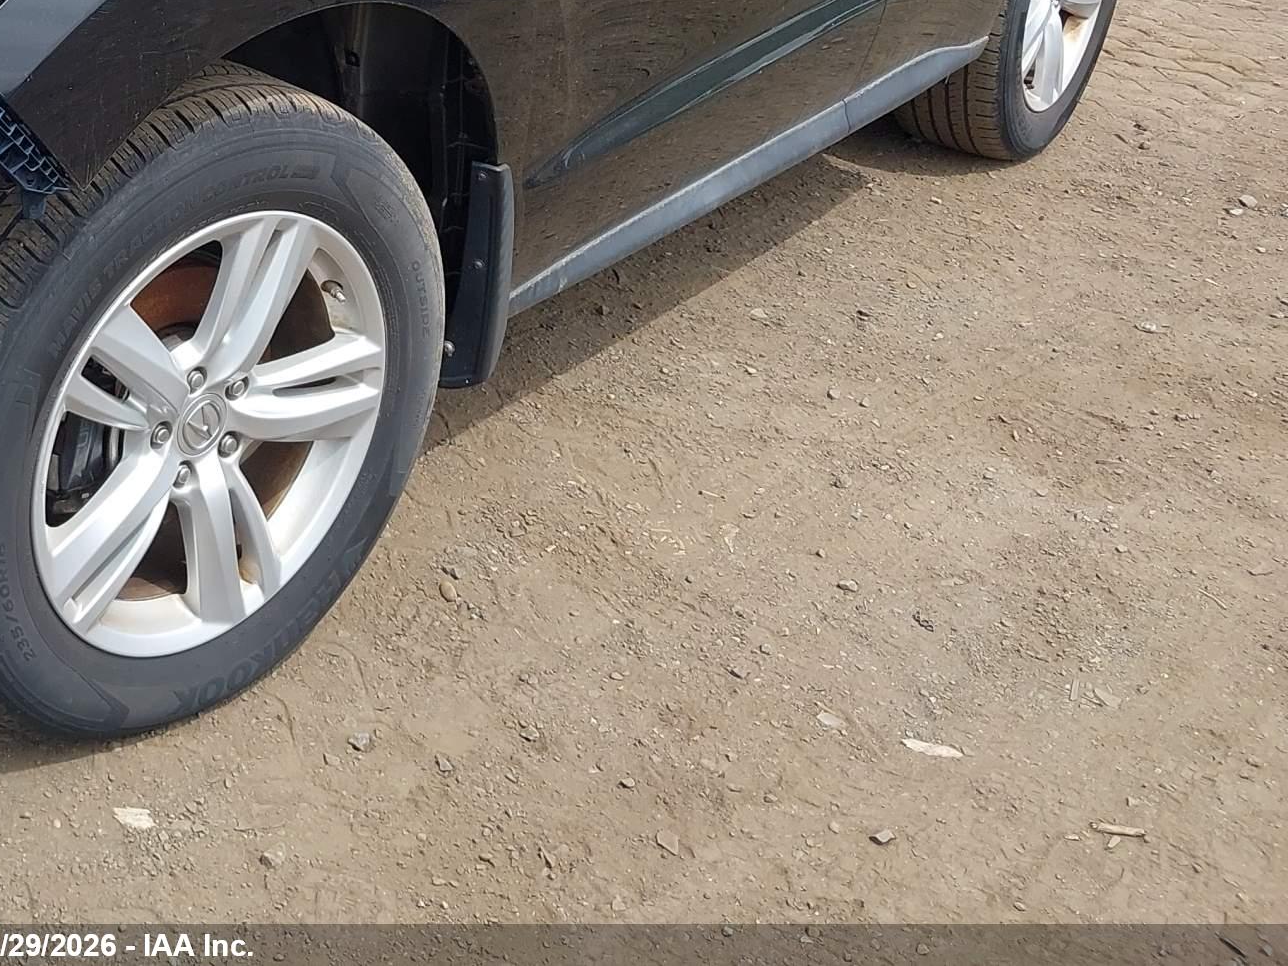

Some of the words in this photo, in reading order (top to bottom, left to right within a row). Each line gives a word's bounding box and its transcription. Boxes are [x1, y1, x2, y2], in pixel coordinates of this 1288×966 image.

[48, 278, 104, 358] MAVIS
[202, 163, 291, 203] CONTROL
[411, 259, 431, 340] OUTSIDE
